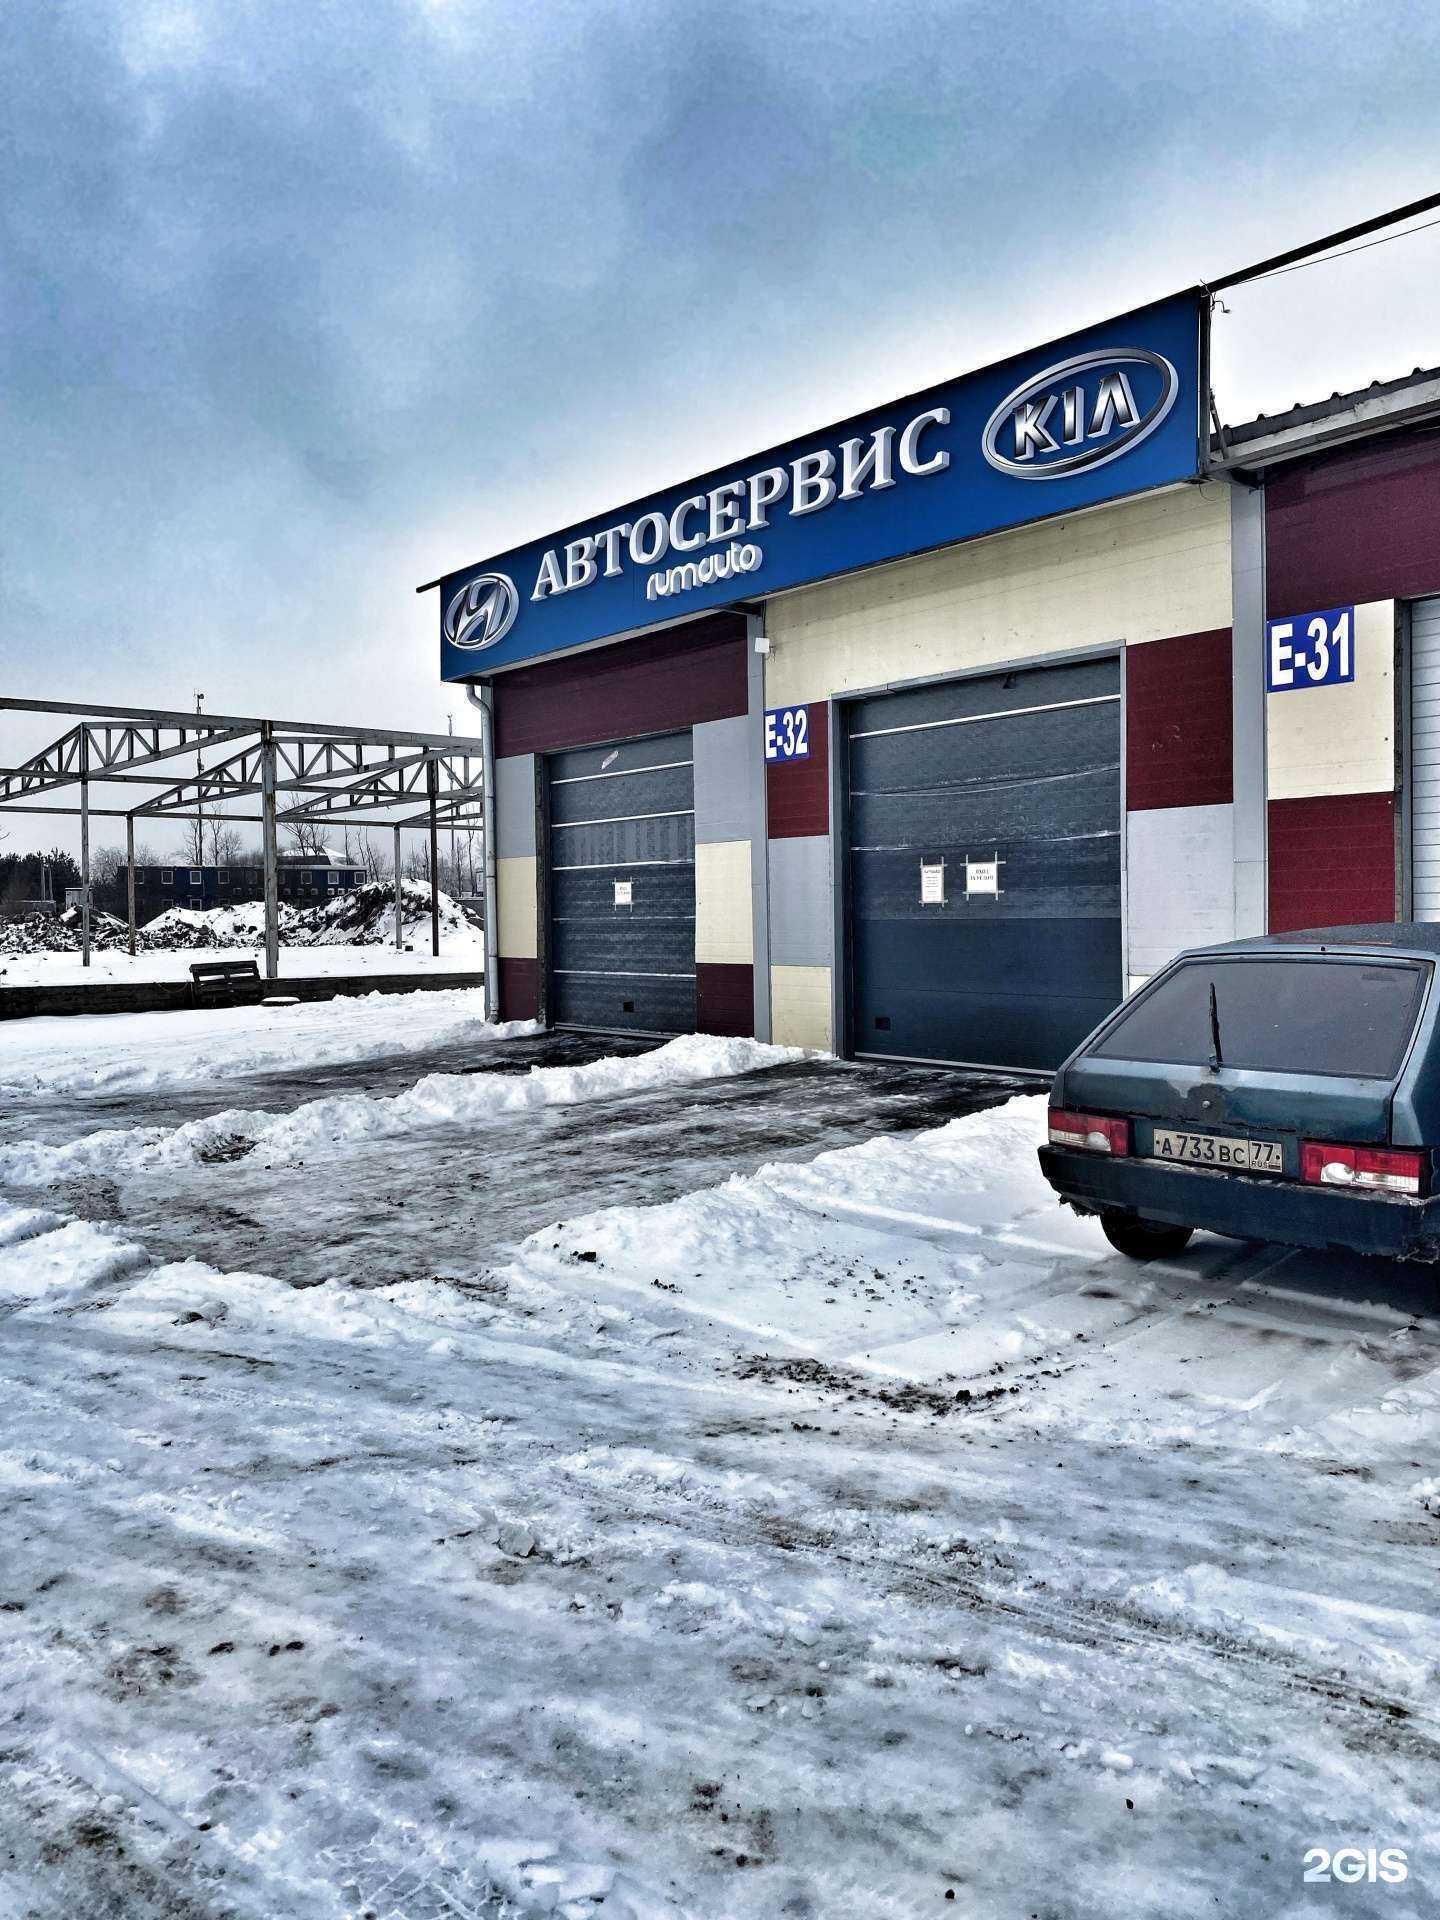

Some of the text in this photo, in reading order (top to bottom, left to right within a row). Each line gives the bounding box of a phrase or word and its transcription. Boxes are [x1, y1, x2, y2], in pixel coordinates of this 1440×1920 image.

[1013, 371, 1141, 461] KIA
[530, 407, 951, 602] АВТОСЕРВИС
[646, 541, 763, 601] rumauto
[1271, 612, 1350, 687] Е-31
[764, 709, 808, 759] Е-32
[1251, 1160, 1269, 1169] RUS
